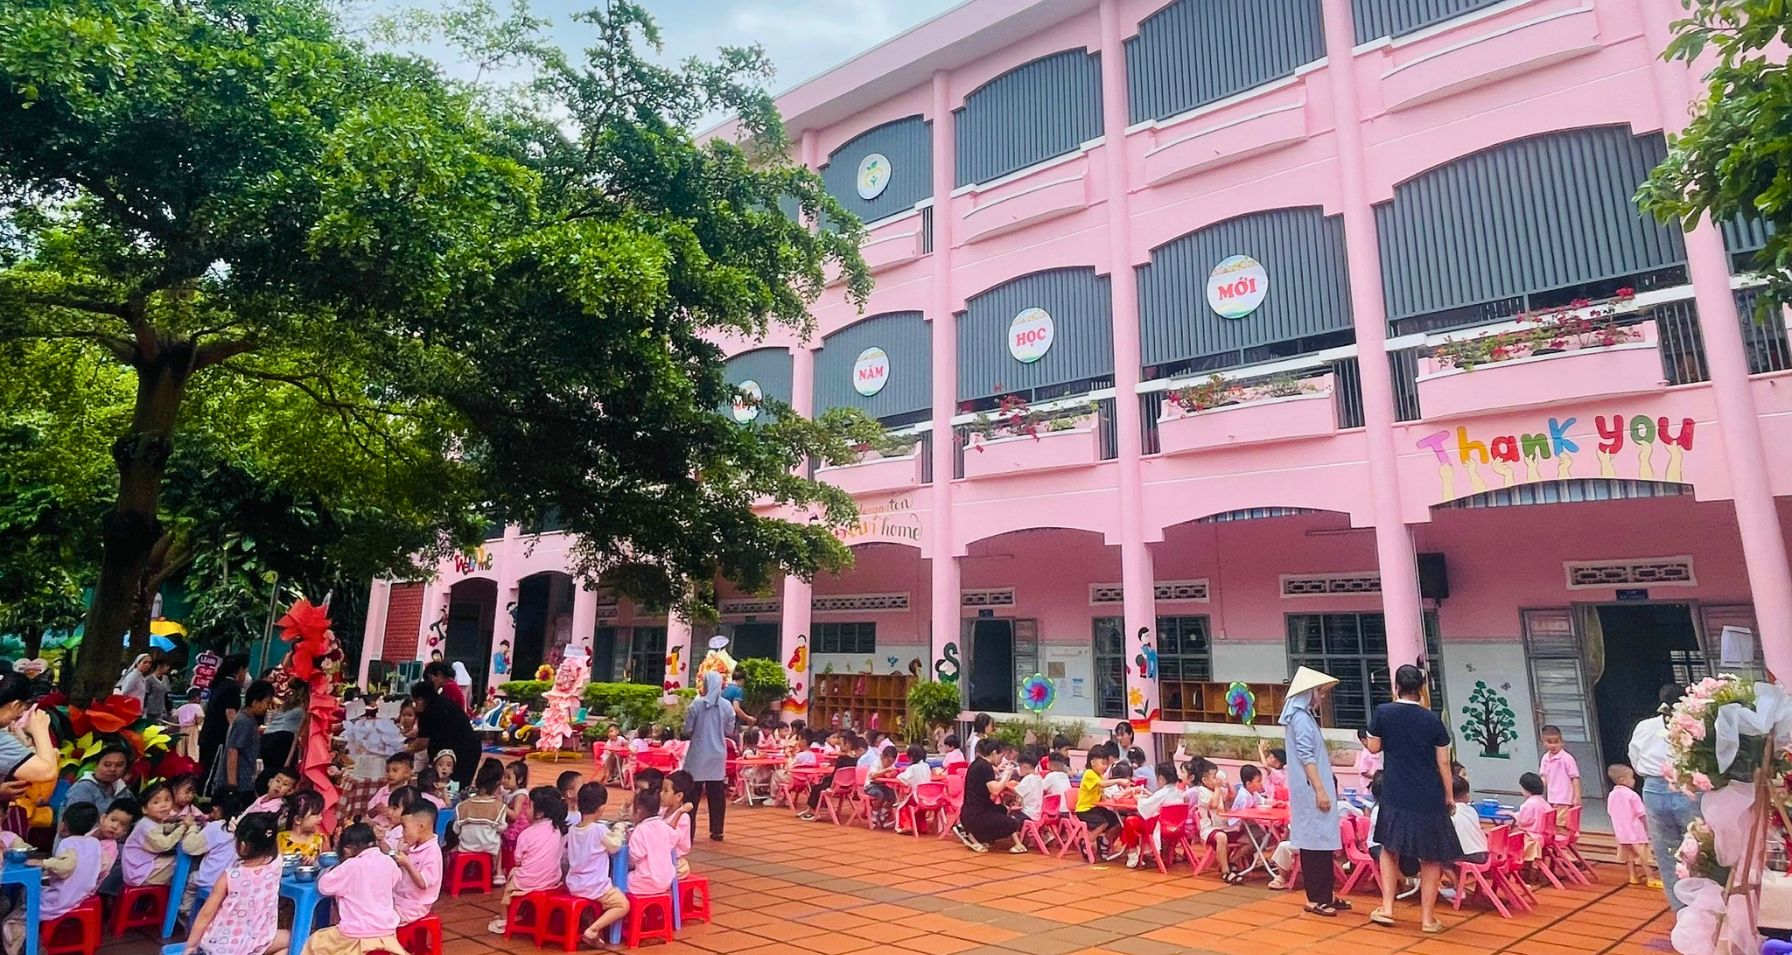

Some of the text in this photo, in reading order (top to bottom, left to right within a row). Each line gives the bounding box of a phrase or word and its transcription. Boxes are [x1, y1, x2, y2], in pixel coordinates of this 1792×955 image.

[1217, 276, 1257, 301] MỚI
[1015, 327, 1046, 347] HỌC
[1595, 414, 1694, 454] you
[880, 513, 923, 541] home
